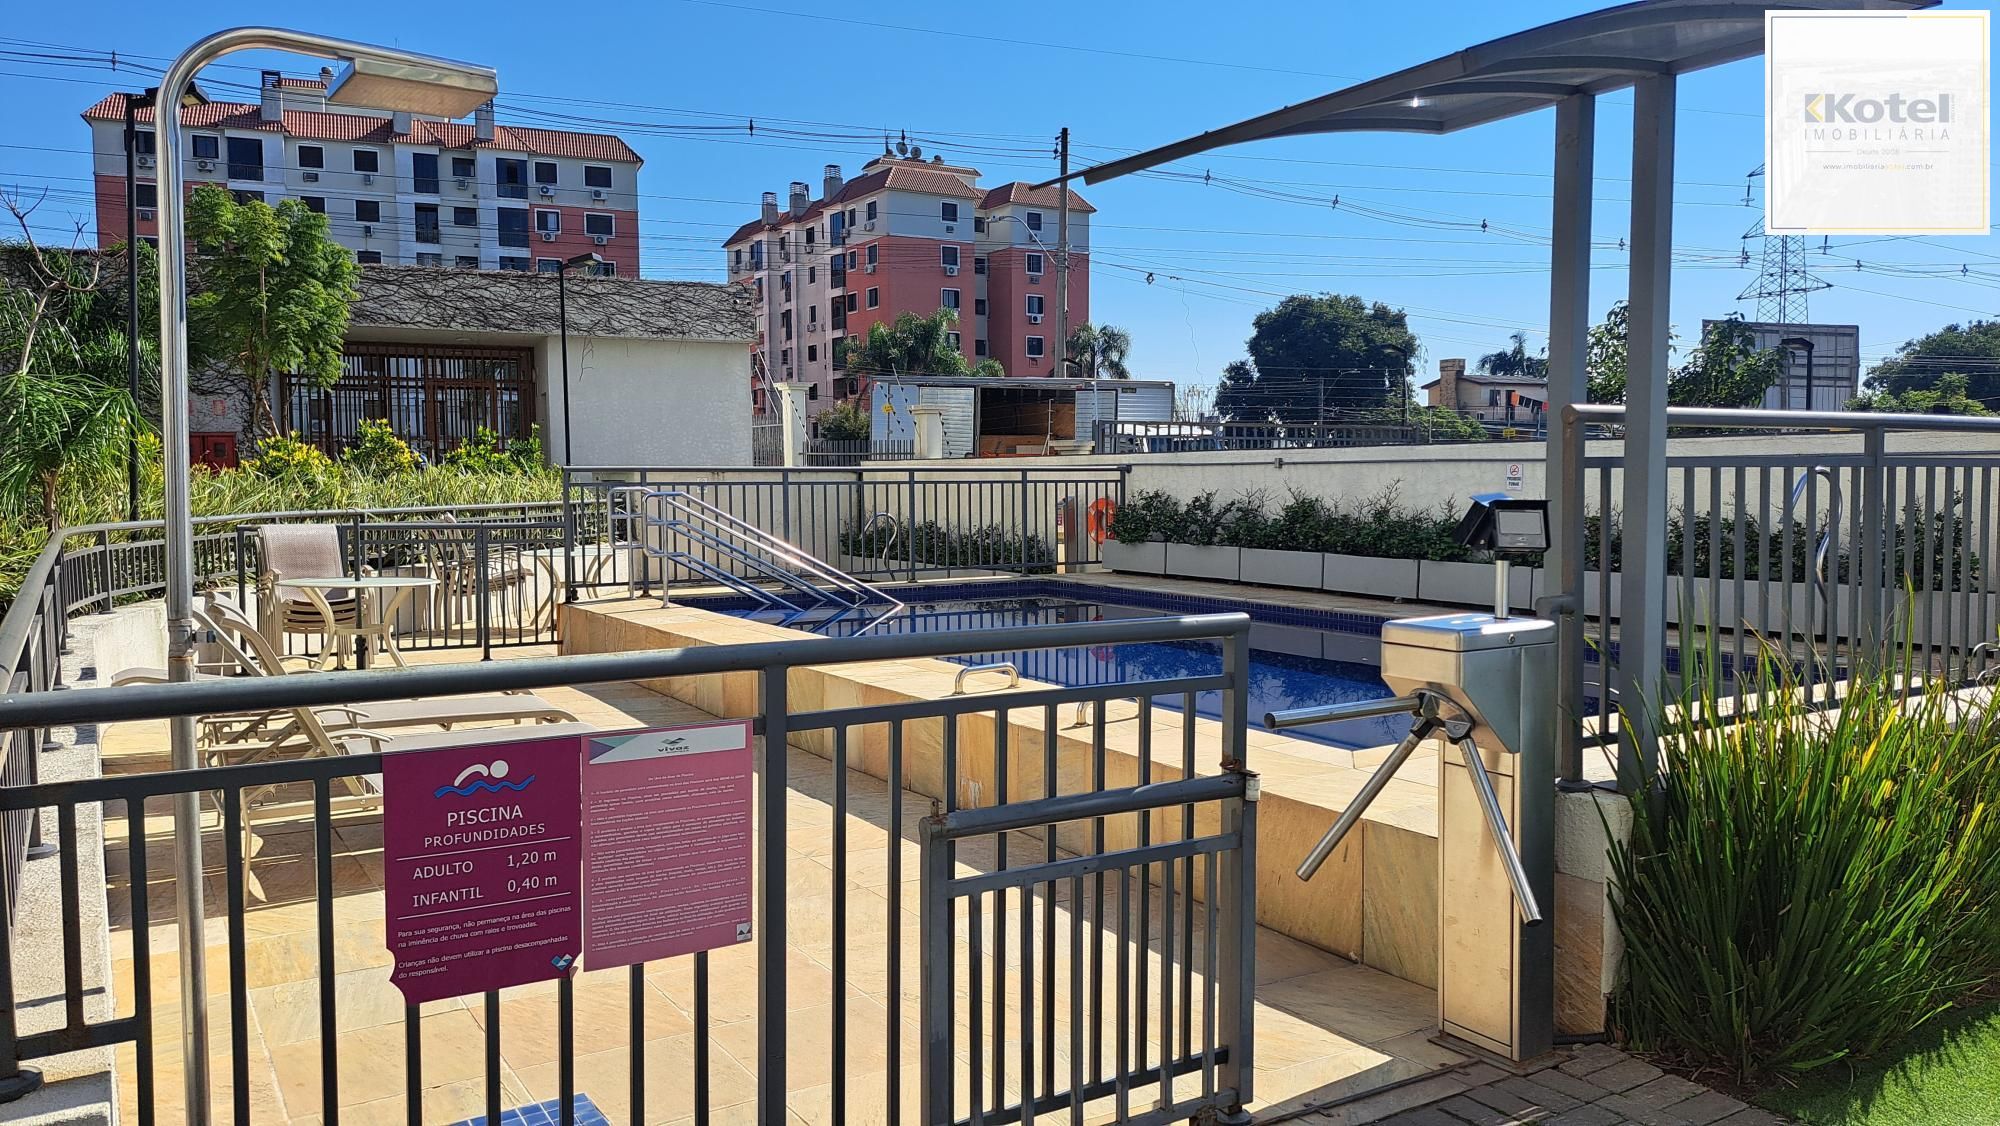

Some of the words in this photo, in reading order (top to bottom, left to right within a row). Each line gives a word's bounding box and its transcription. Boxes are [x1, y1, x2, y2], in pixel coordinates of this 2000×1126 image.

[447, 805, 523, 826] PISCINA
[424, 823, 545, 848] PROFUNDIDADES
[413, 861, 473, 879] ADULTO
[507, 851, 539, 869] 1,20
[544, 850, 557, 862] m
[413, 887, 484, 907] INFANTIL
[507, 876, 540, 894] 0,40
[545, 875, 558, 887] m
[427, 924, 462, 933] segurança,
[463, 920, 476, 928] não
[477, 916, 511, 926] permaneça
[521, 911, 535, 919] área
[548, 905, 572, 915] piscinas
[408, 937, 439, 947] iminência
[450, 932, 469, 940] chuva
[484, 927, 500, 935] raios
[398, 959, 426, 969] Crianças
[441, 953, 463, 962] devem
[463, 949, 485, 958] utilizar
[491, 944, 513, 954] piscina
[514, 935, 568, 950] desacompanhadas
[408, 965, 449, 977] responsável.
